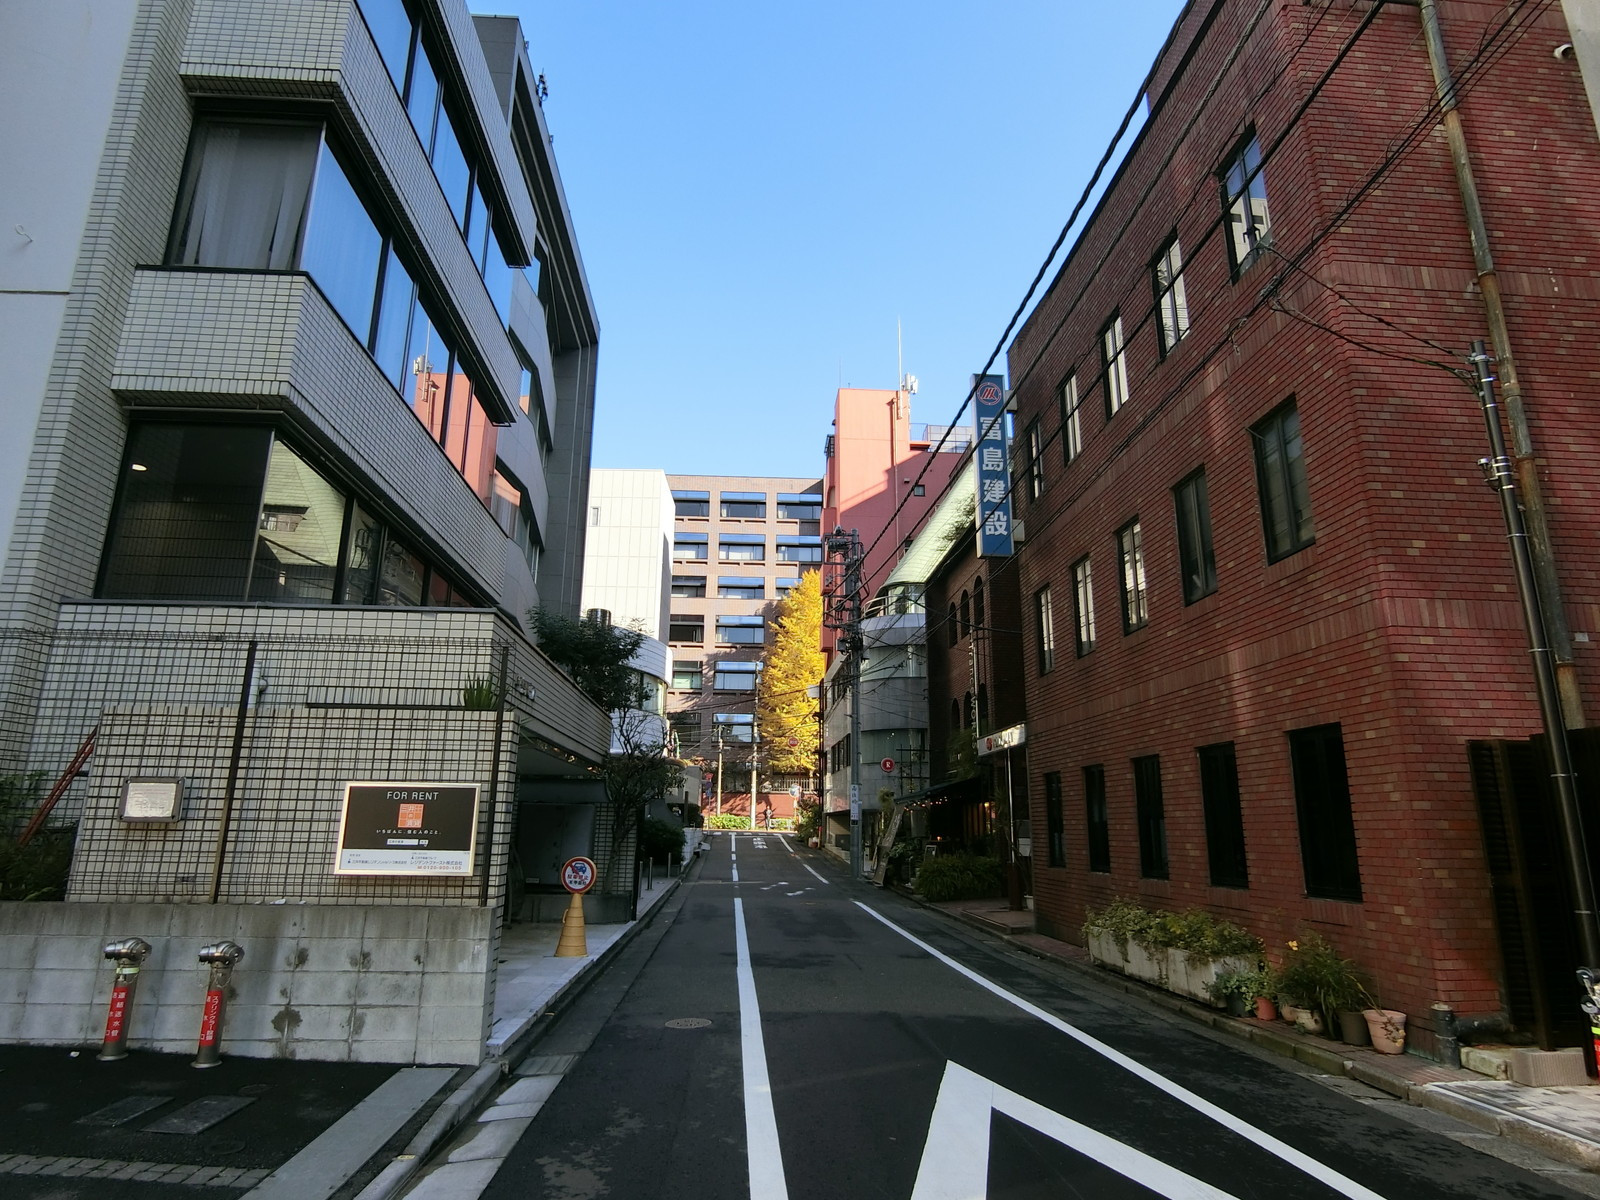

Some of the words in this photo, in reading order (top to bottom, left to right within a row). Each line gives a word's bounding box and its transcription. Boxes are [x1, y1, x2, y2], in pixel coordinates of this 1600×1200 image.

[386, 791, 408, 800] FOR
[411, 791, 439, 800] RENT
[111, 991, 127, 1037] 連結送水管
